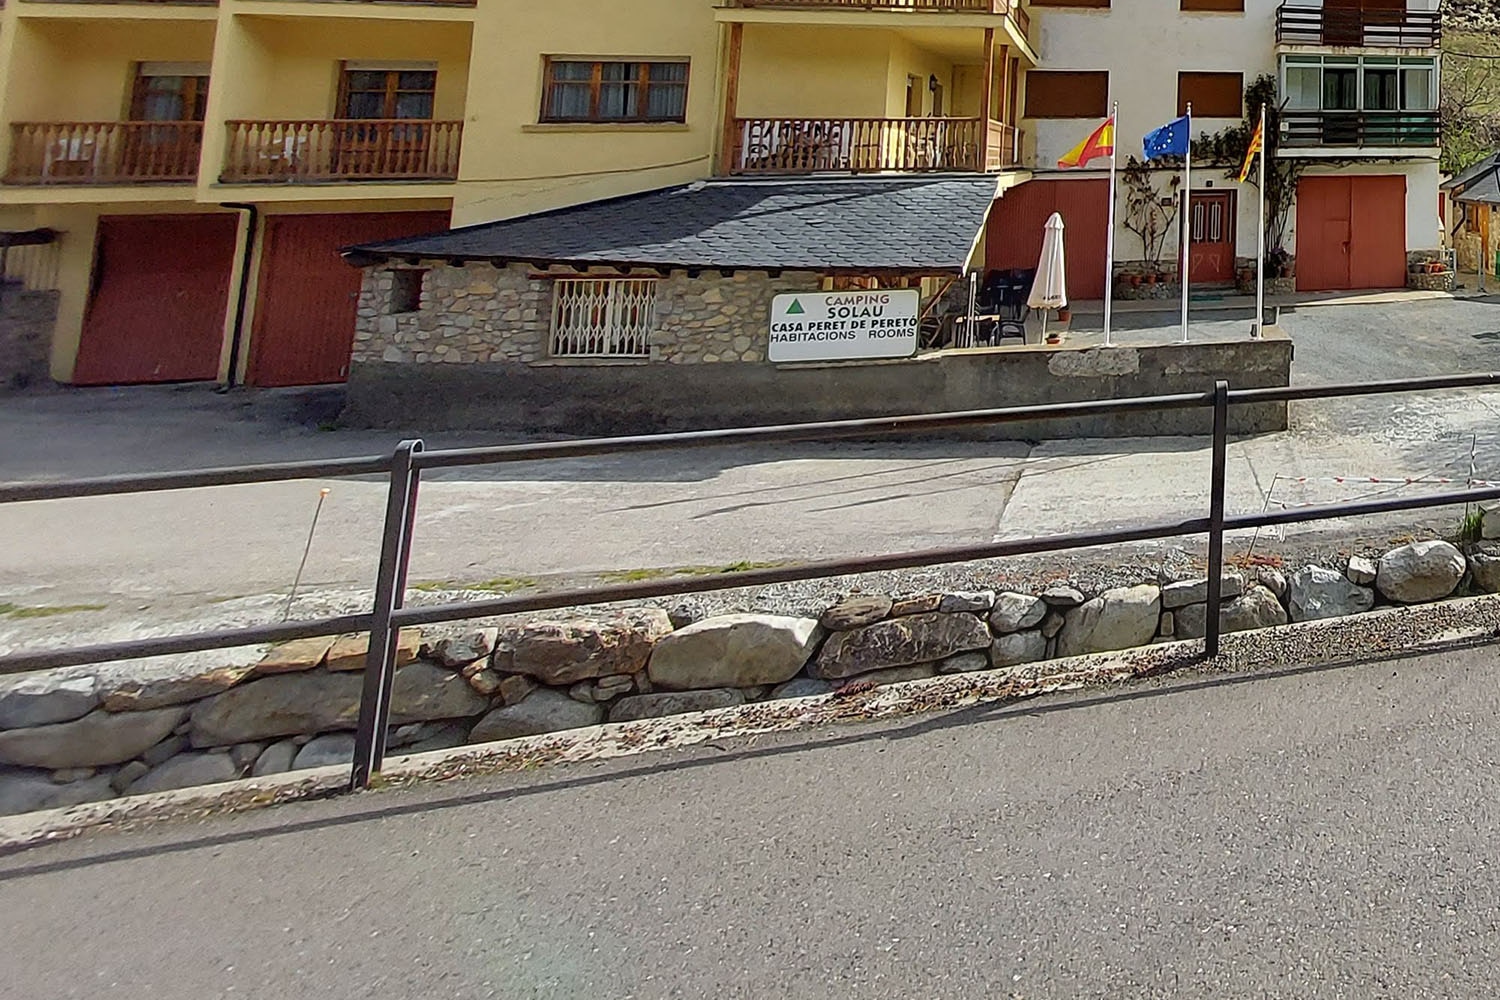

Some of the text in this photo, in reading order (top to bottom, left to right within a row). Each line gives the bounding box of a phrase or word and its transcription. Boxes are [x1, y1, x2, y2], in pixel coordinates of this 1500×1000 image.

[825, 295, 890, 306] CAMPING
[827, 306, 884, 319] SOLAU
[771, 315, 918, 333] CASA PERET DE PERETÓ
[770, 328, 915, 343] HABITACIONS ROOMS
